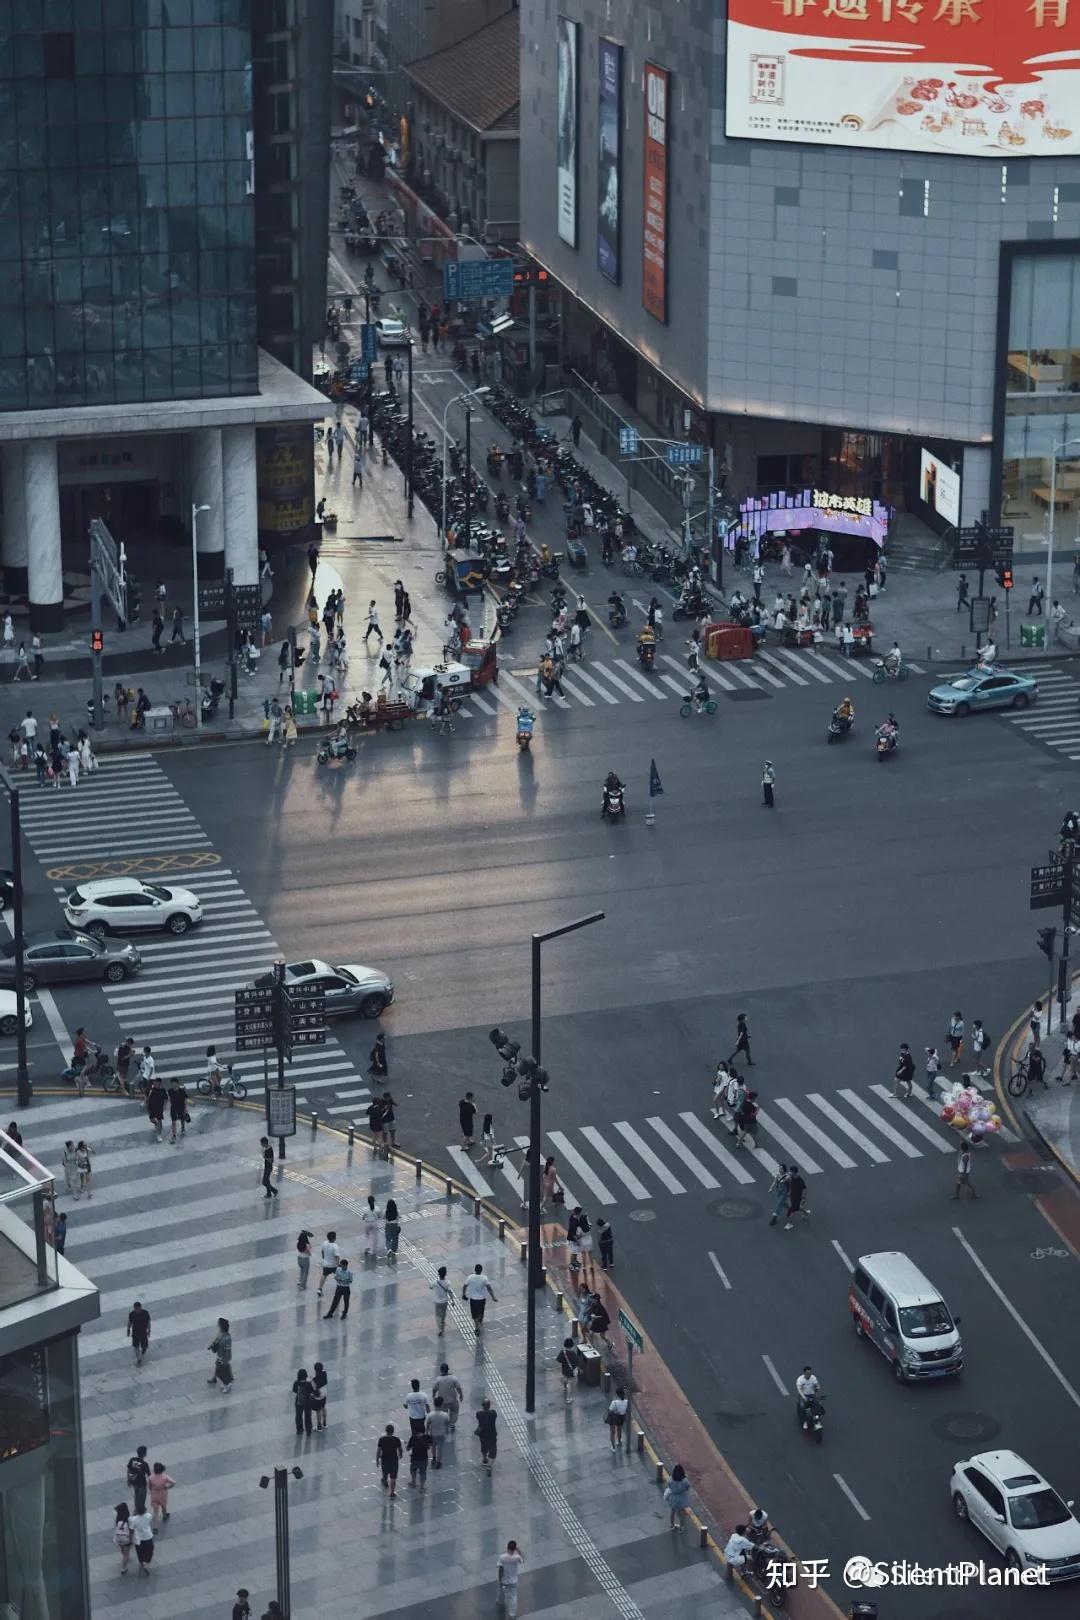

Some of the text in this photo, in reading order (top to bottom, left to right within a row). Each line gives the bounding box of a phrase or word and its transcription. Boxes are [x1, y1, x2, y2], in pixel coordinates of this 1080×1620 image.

[448, 264, 457, 277] P
[813, 488, 872, 517] 城市英雄
